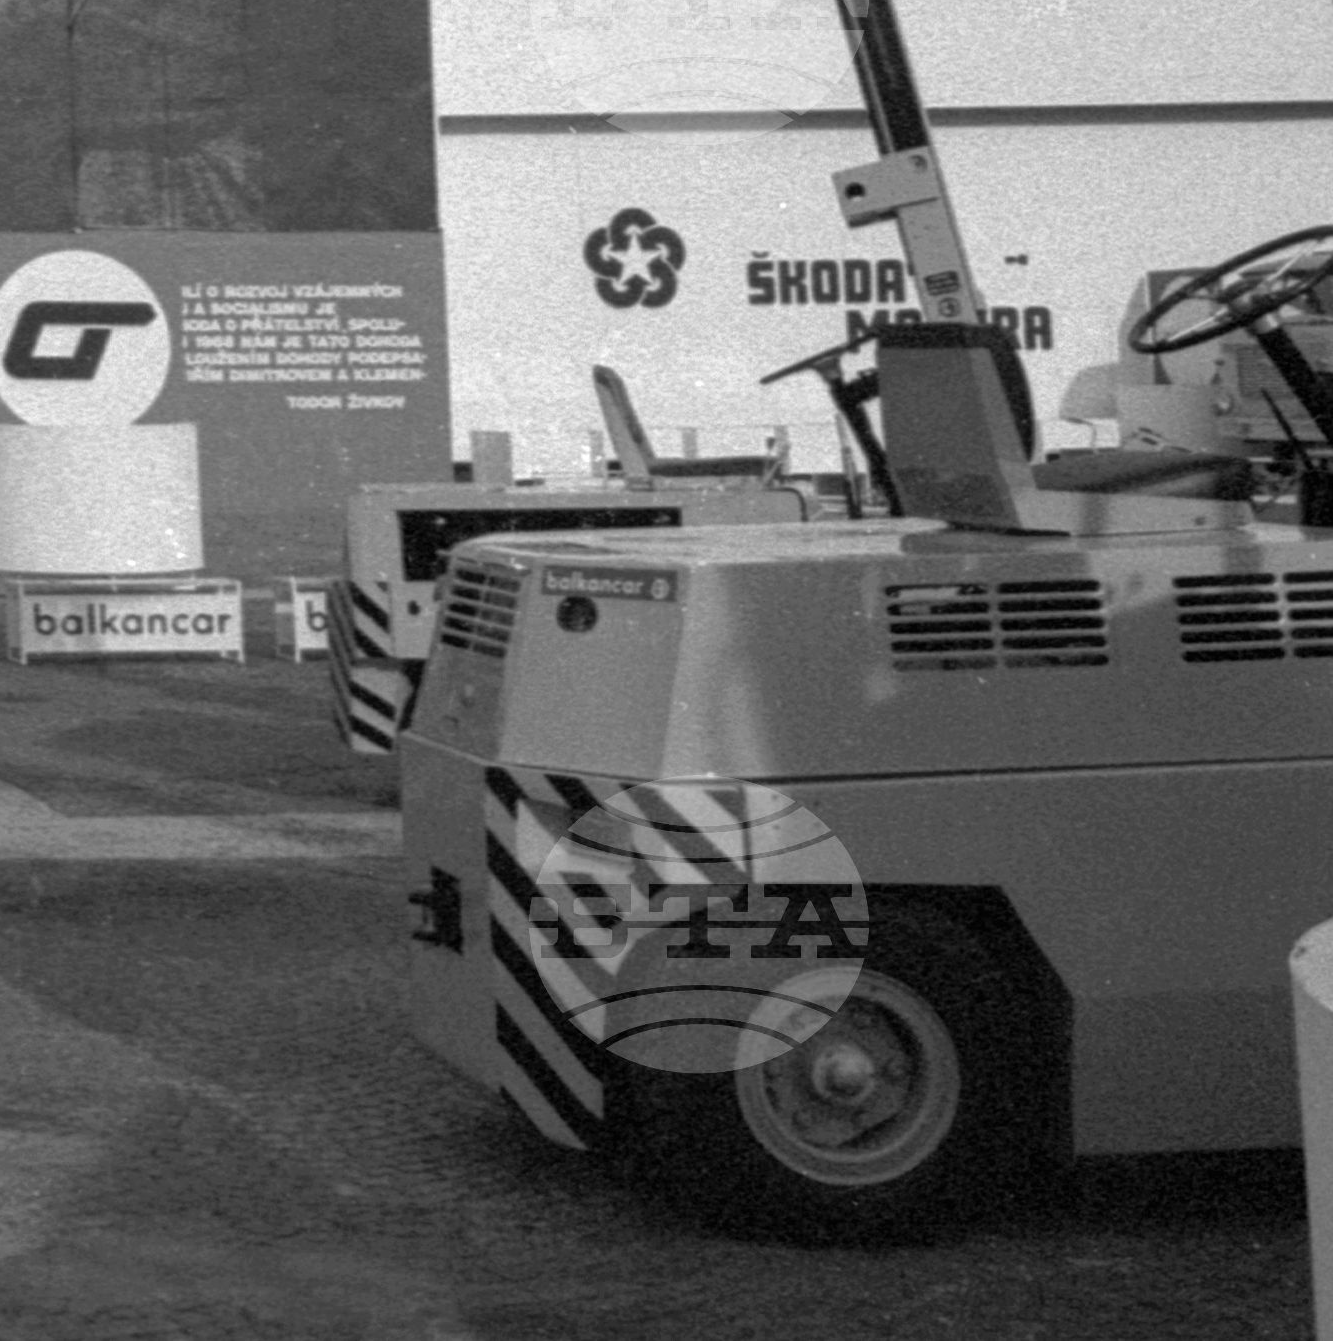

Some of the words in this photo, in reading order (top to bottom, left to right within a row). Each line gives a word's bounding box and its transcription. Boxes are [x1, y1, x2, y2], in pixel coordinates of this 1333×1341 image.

[747, 251, 907, 305] ŠKODA
[193, 302, 207, 316] A
[314, 301, 337, 315] JE
[336, 368, 350, 382] A
[545, 569, 645, 595] balkancar
[33, 602, 232, 636] balkancar
